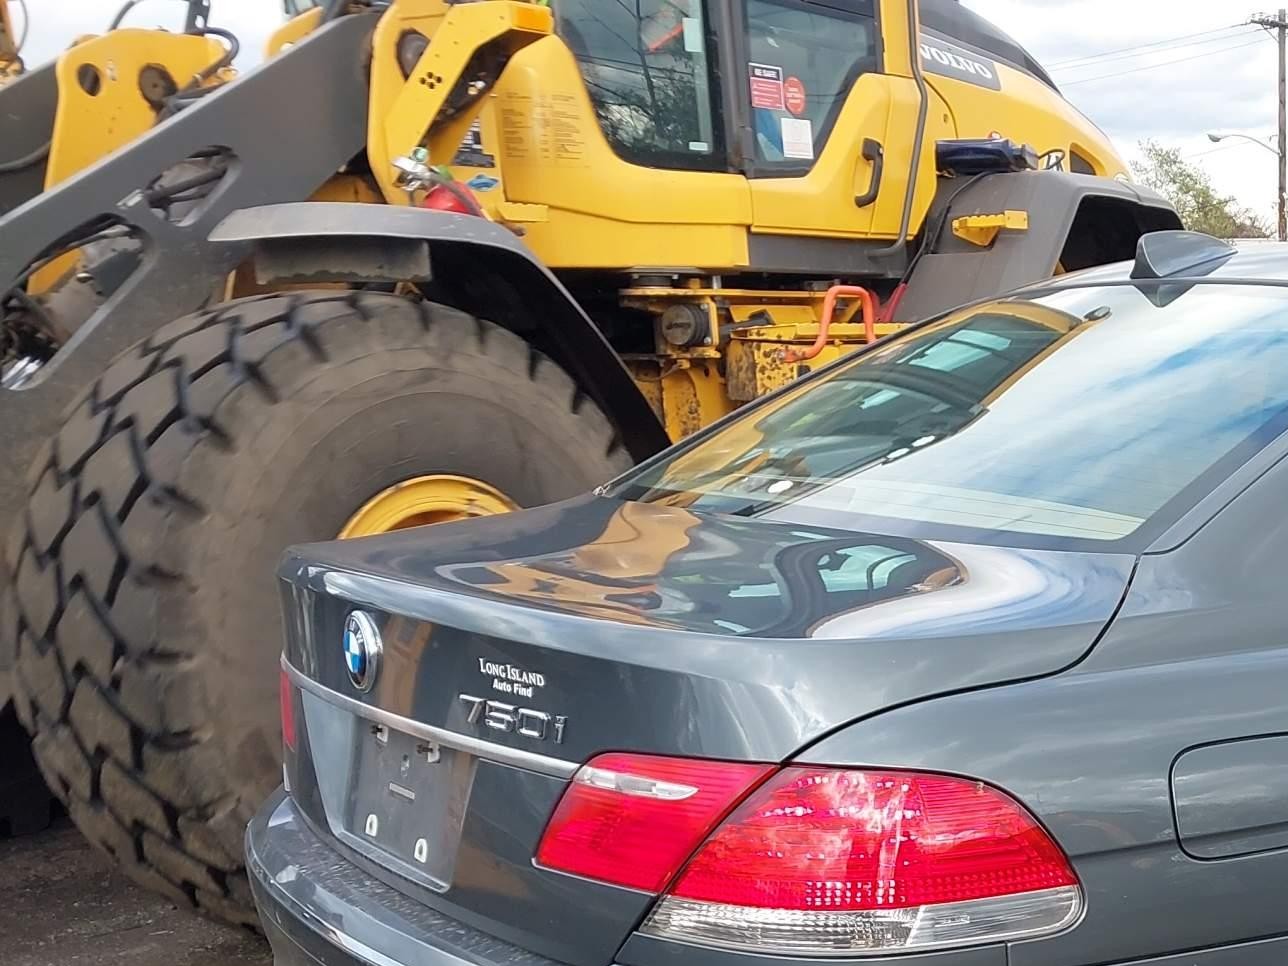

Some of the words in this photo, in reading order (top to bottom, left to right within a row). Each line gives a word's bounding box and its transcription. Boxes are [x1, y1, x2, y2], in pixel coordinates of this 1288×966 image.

[920, 43, 993, 79] VOLVO
[493, 678, 512, 693] Auto
[513, 682, 532, 698] Find
[459, 694, 568, 744] 750i
